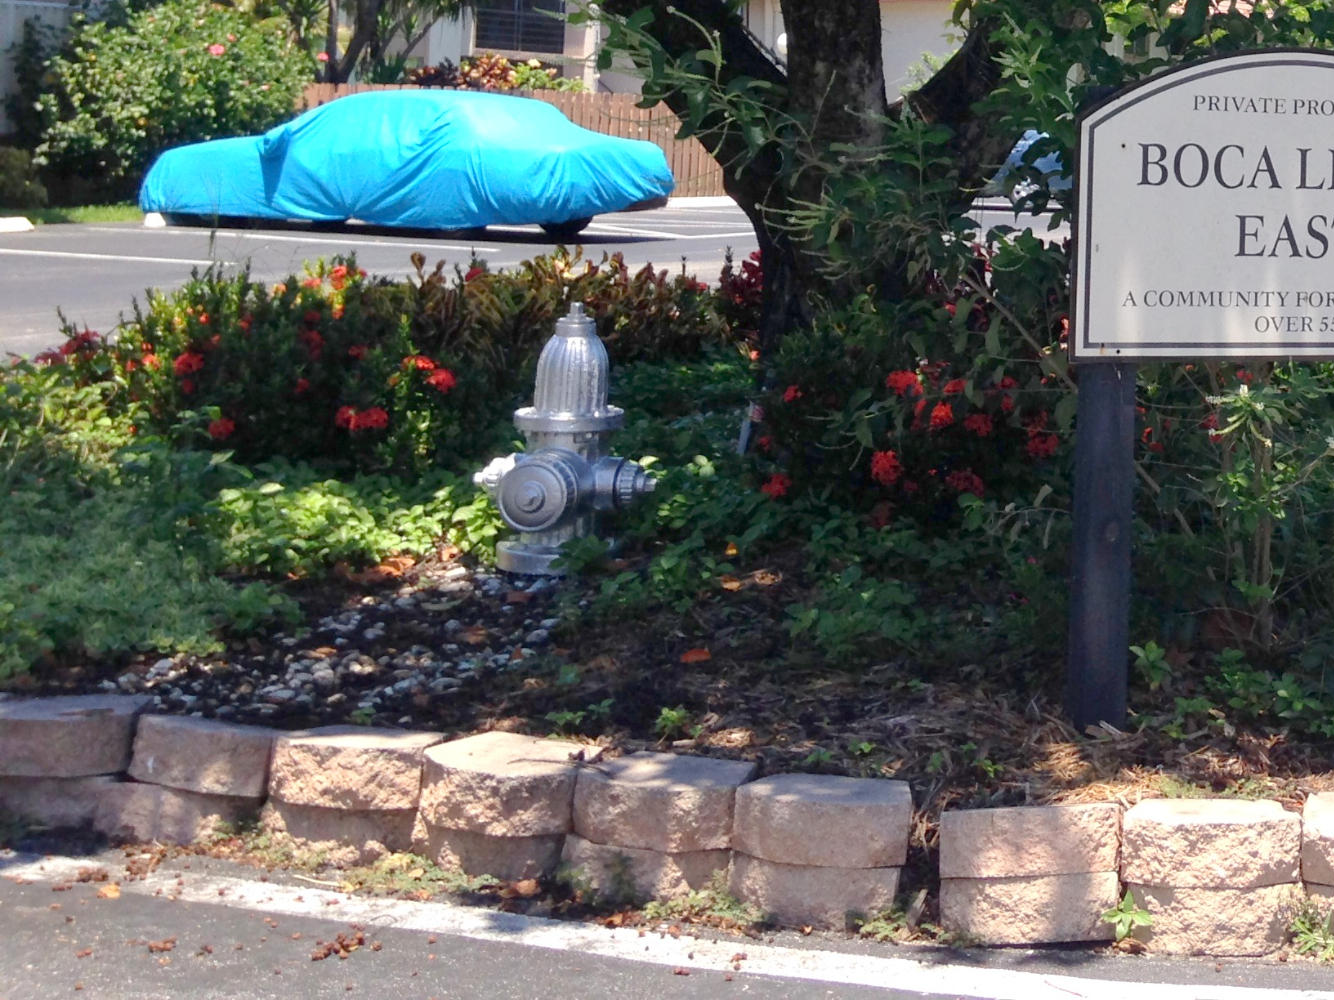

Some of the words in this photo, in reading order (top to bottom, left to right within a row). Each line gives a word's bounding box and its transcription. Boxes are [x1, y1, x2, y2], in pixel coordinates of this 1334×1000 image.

[1193, 95, 1286, 114] PRIVATE
[1137, 143, 1282, 189] BOCA
[1122, 291, 1137, 307] A
[1143, 290, 1289, 308] COMMUNITY
[1254, 316, 1313, 333] OVER
